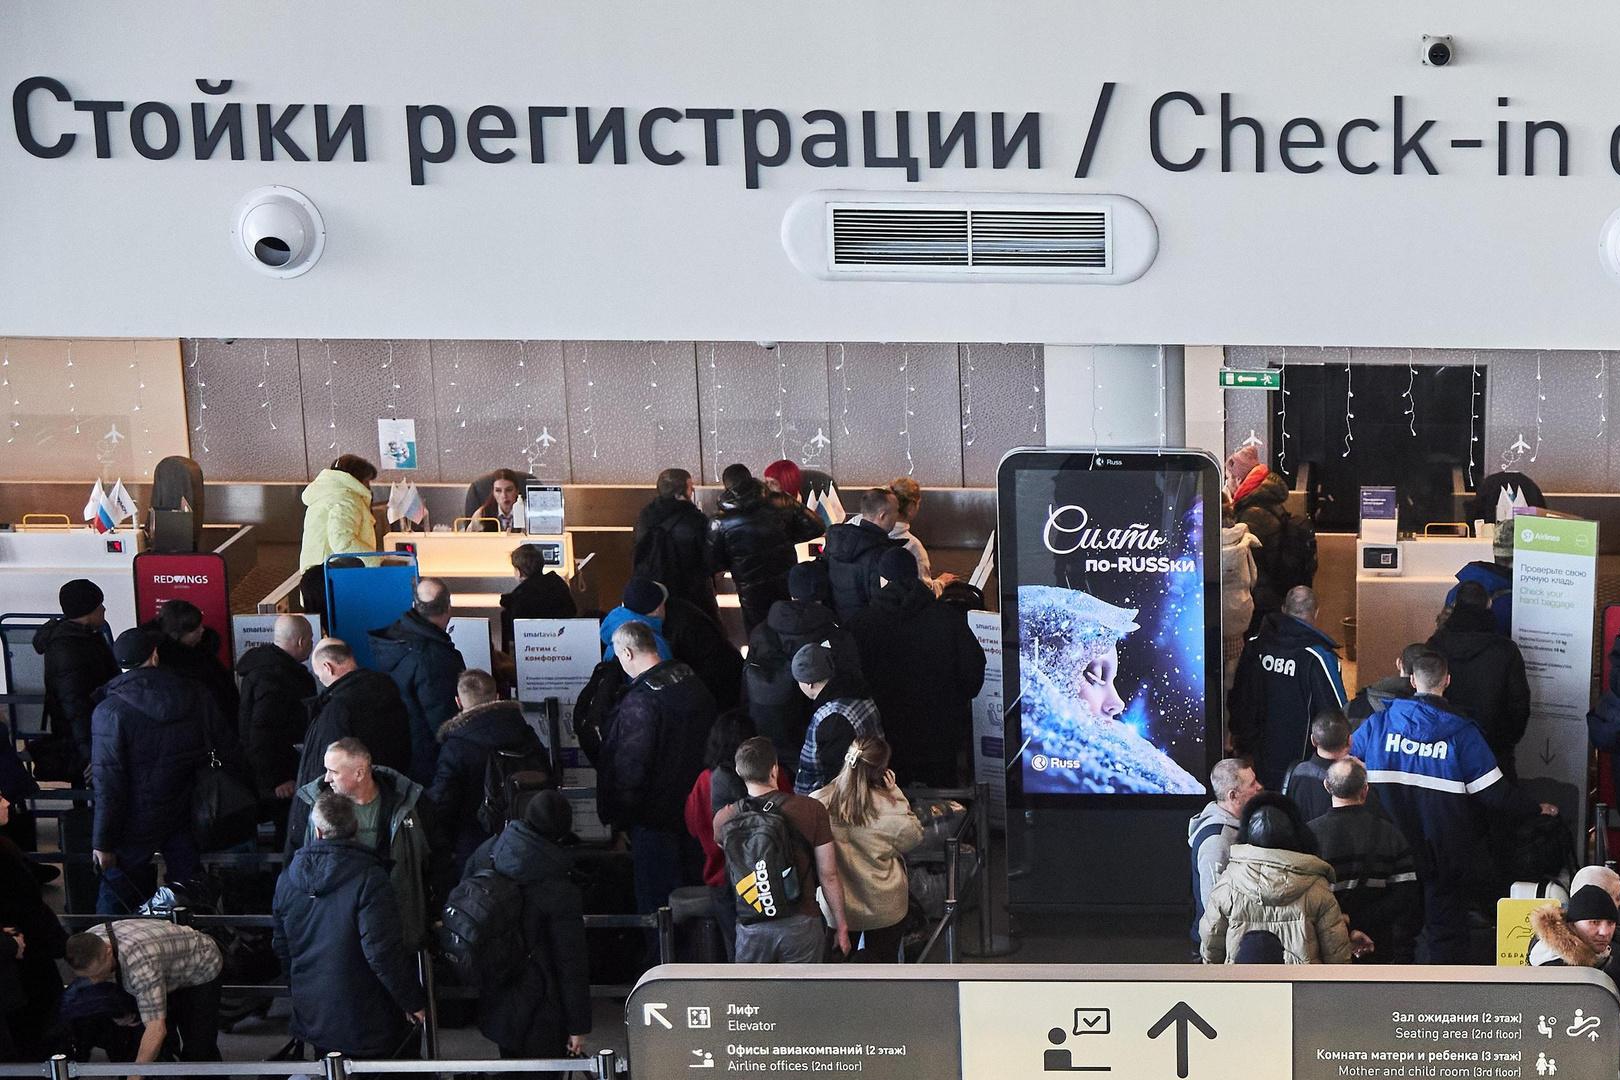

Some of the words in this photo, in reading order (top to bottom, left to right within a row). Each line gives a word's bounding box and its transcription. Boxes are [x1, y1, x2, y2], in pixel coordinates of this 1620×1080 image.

[13, 76, 367, 162] Стойки
[408, 105, 1041, 190] регистрации
[1075, 82, 1117, 178] /
[1150, 91, 1569, 176] Check-in
[524, 629, 556, 638] smartavia
[525, 654, 572, 662] комфортом
[1259, 654, 1296, 676] ОВА
[1386, 733, 1448, 760] НОВА
[1051, 758, 1080, 769] Russ
[755, 859, 777, 917] adidas
[727, 1004, 759, 1017] Лифт
[1392, 1012, 1414, 1022] Зал
[1418, 1013, 1478, 1024] ожидания
[1494, 1013, 1522, 1023] этаж)
[729, 1020, 776, 1030] Elevator
[1396, 1027, 1438, 1041] Seating
[1443, 1030, 1469, 1038] area
[1471, 1028, 1492, 1039] (2nd
[1495, 1029, 1521, 1039] floor)
[727, 1044, 770, 1057] Офисы
[773, 1044, 862, 1055] авиакомпаний
[878, 1045, 905, 1055] этаж)
[1317, 1049, 1368, 1059] Комната
[1372, 1051, 1415, 1062] матери
[1429, 1050, 1479, 1062] ребенка
[1494, 1051, 1521, 1061] этаж)
[728, 1061, 767, 1071] Airline
[770, 1060, 808, 1071] offices
[812, 1061, 832, 1071] (2nd
[836, 1061, 861, 1071] floor)
[1338, 1066, 1380, 1076] Mother
[1384, 1066, 1405, 1076] and
[1409, 1066, 1436, 1076] child
[1439, 1068, 1470, 1077] room
[1474, 1067, 1493, 1077] (3rd
[1495, 1067, 1522, 1077] floor)
